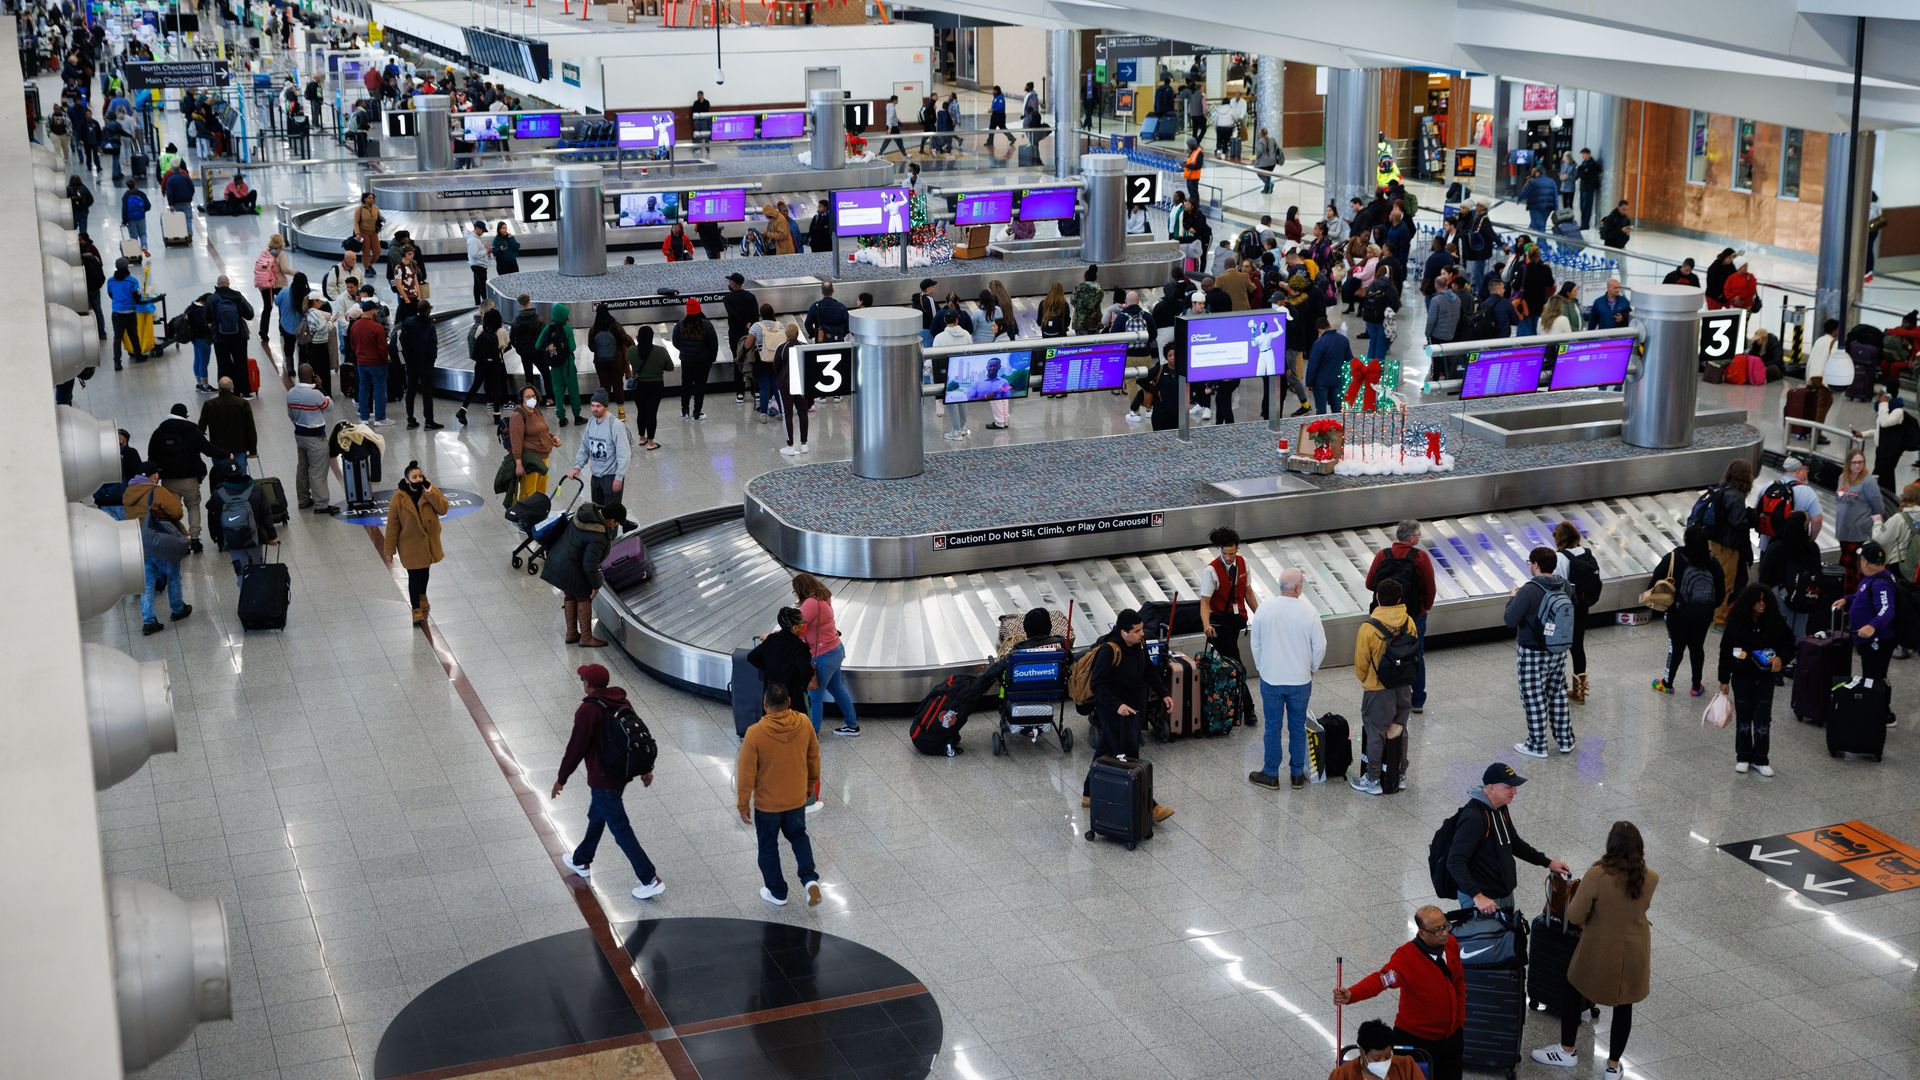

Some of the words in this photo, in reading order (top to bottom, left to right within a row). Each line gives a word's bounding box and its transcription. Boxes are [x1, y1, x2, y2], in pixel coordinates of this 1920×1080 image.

[398, 114, 406, 135] 1
[854, 106, 860, 126] 1
[1133, 177, 1150, 203] 2
[531, 193, 550, 220] 2
[1705, 320, 1732, 356] 3
[1047, 349, 1054, 357] 3
[1470, 353, 1477, 362] 3
[1560, 345, 1566, 353] 3
[814, 354, 842, 392] 3
[950, 534, 986, 545] Caution!
[988, 533, 1001, 542] Do
[1004, 530, 1019, 539] Not
[1021, 529, 1035, 538] Sit,
[1037, 526, 1064, 536] Climb,
[1078, 522, 1095, 532] Play
[1098, 520, 1110, 529] On
[1112, 516, 1149, 528] Carousel
[1013, 668, 1056, 677] Southwest
